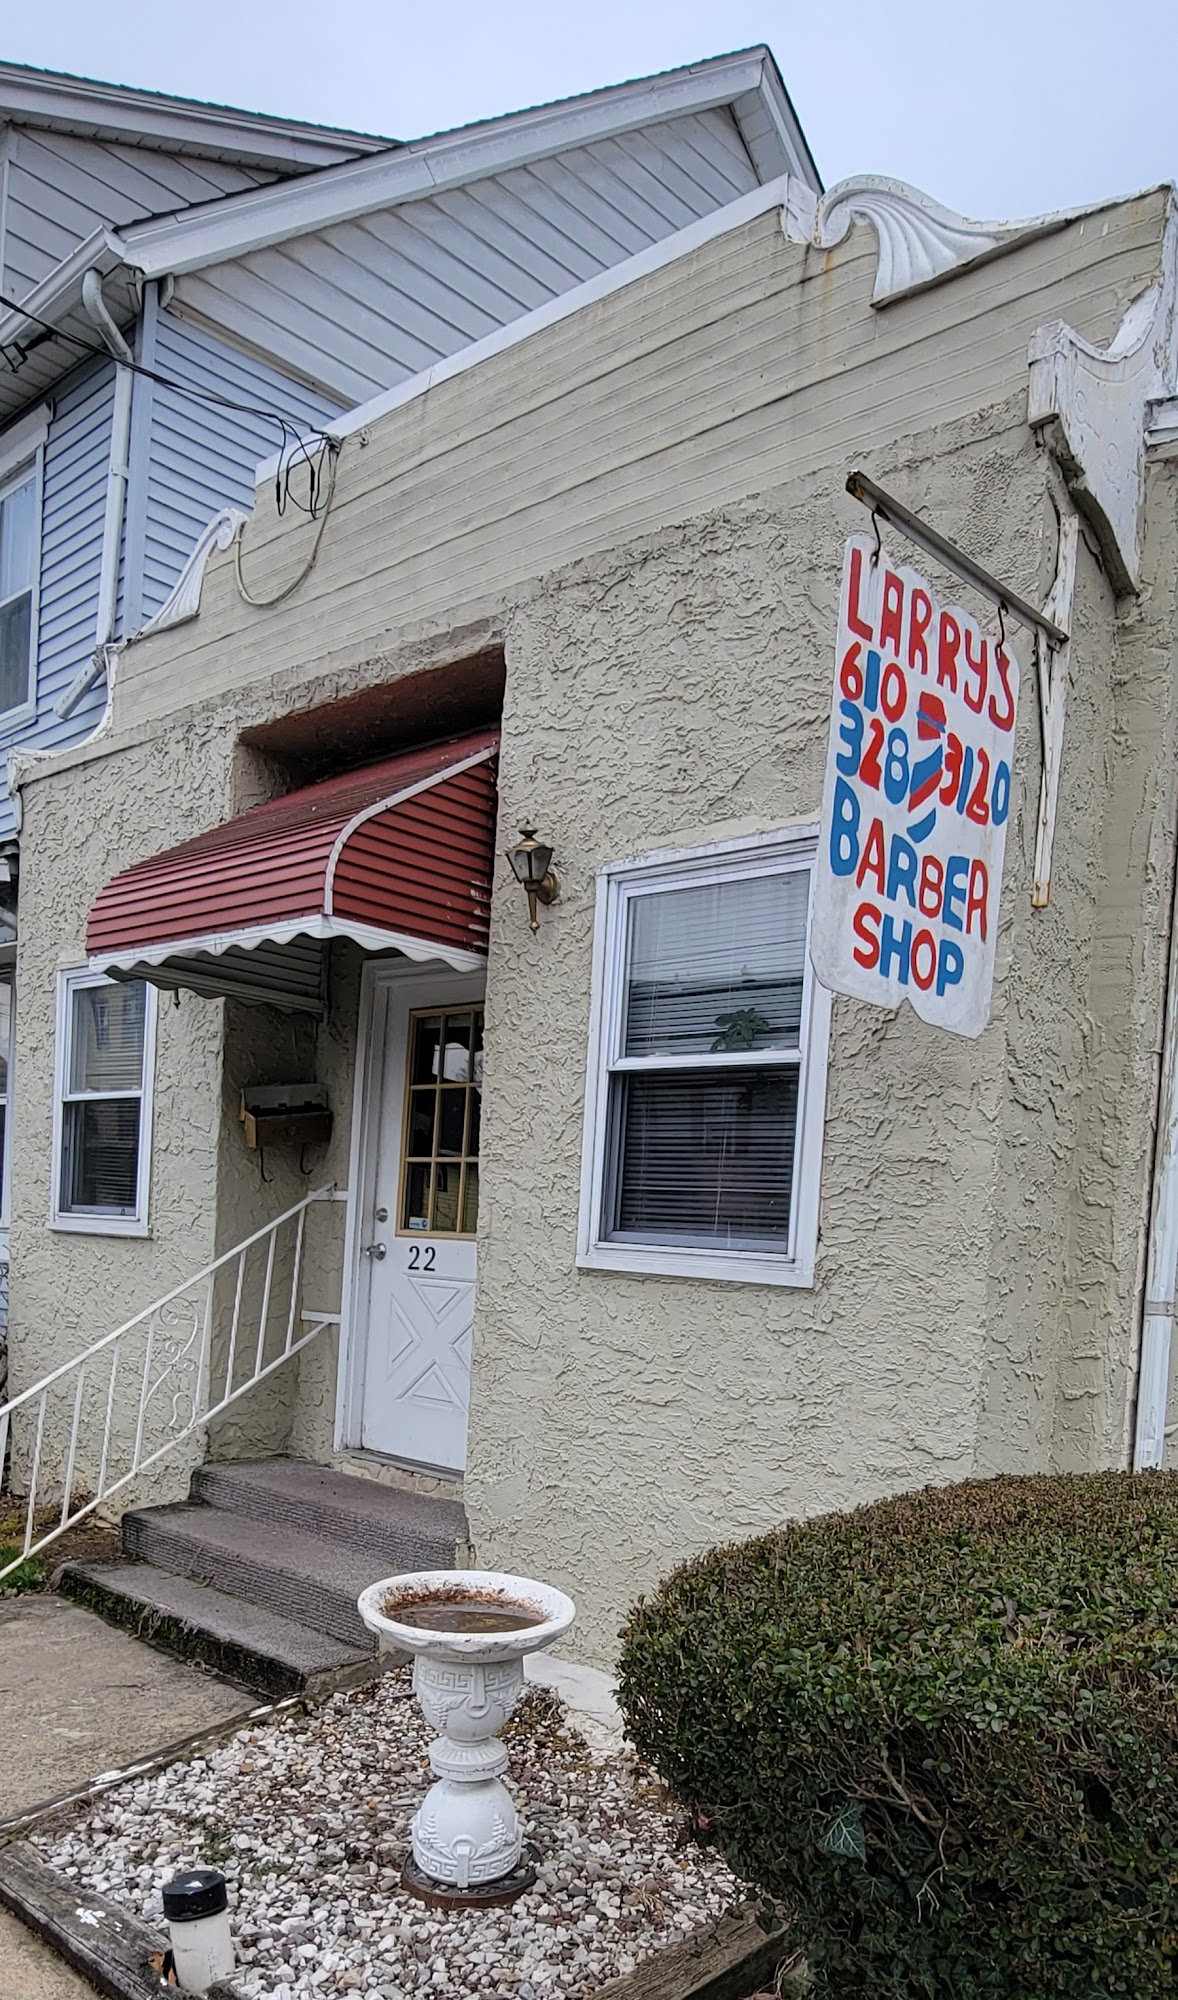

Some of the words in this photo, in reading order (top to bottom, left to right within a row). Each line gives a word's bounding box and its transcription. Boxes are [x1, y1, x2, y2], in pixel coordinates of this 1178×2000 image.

[840, 642, 907, 723] 610
[848, 548, 1014, 732] LARRYS
[836, 699, 909, 805] 328
[939, 732, 1011, 826] 3120
[830, 776, 988, 942] BARBER
[853, 902, 964, 997] SHOP
[408, 1246, 436, 1271] 22
